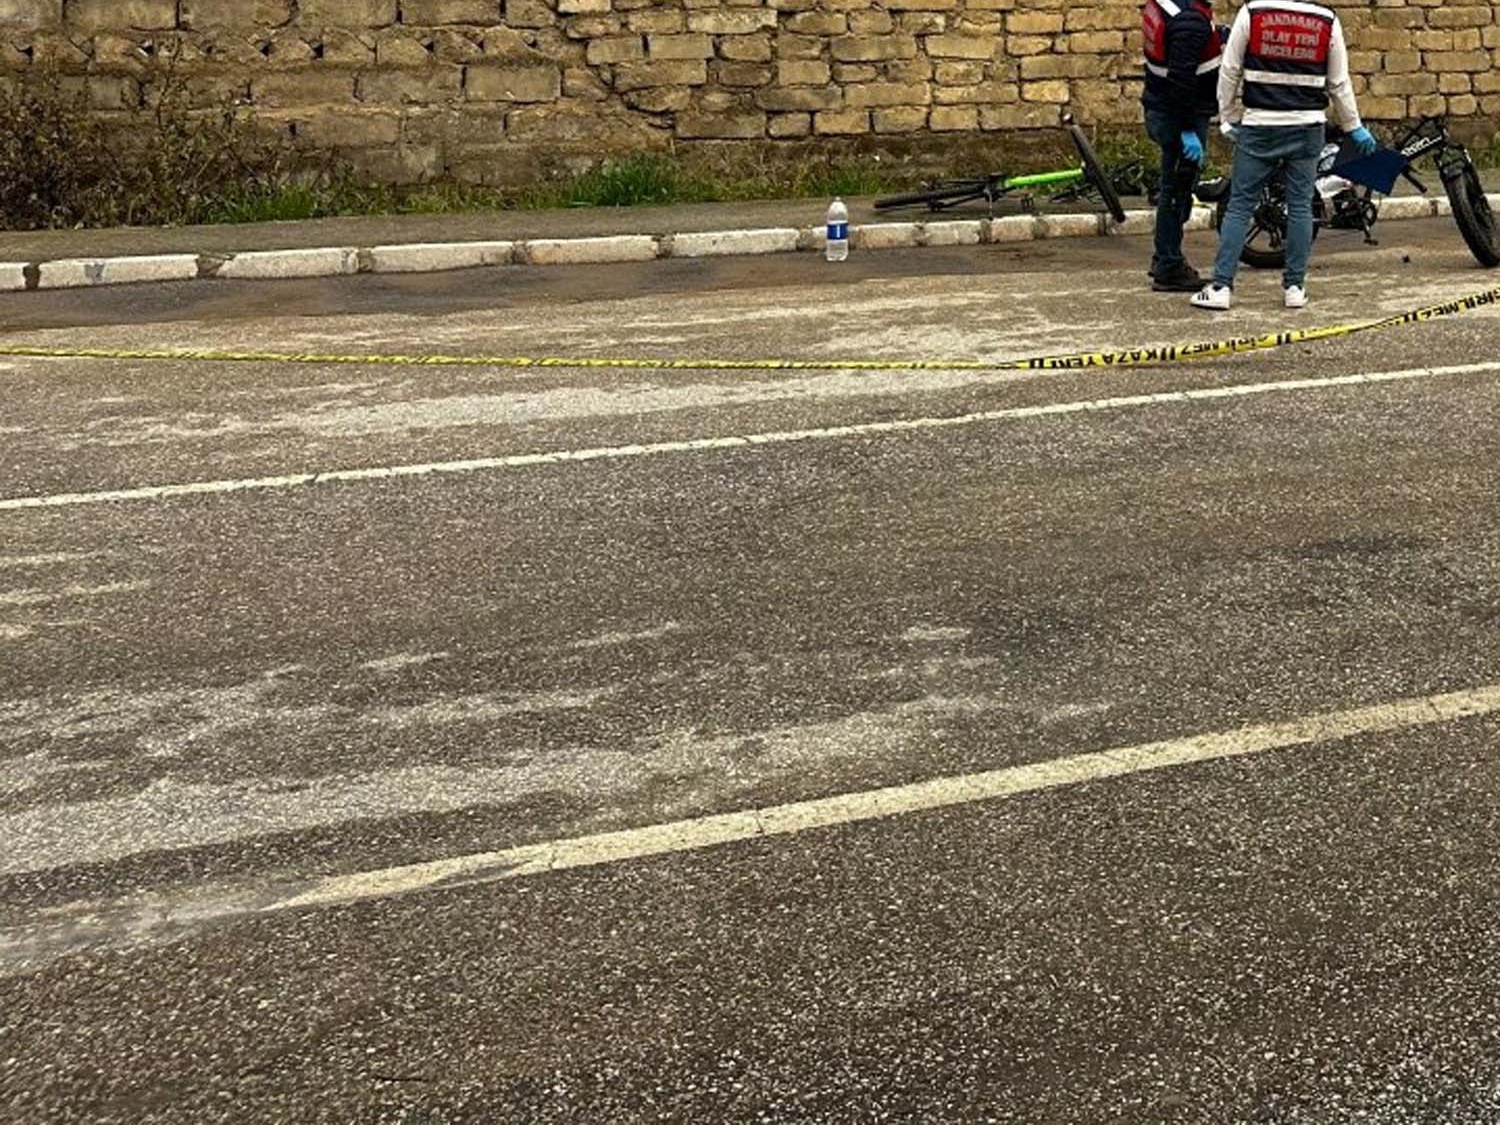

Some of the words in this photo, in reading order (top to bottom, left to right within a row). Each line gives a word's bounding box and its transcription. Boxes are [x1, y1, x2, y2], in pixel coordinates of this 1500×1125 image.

[1260, 13, 1323, 32] JANDARMA
[1262, 29, 1291, 43] OLAY
[1102, 349, 1157, 366] KAZA
